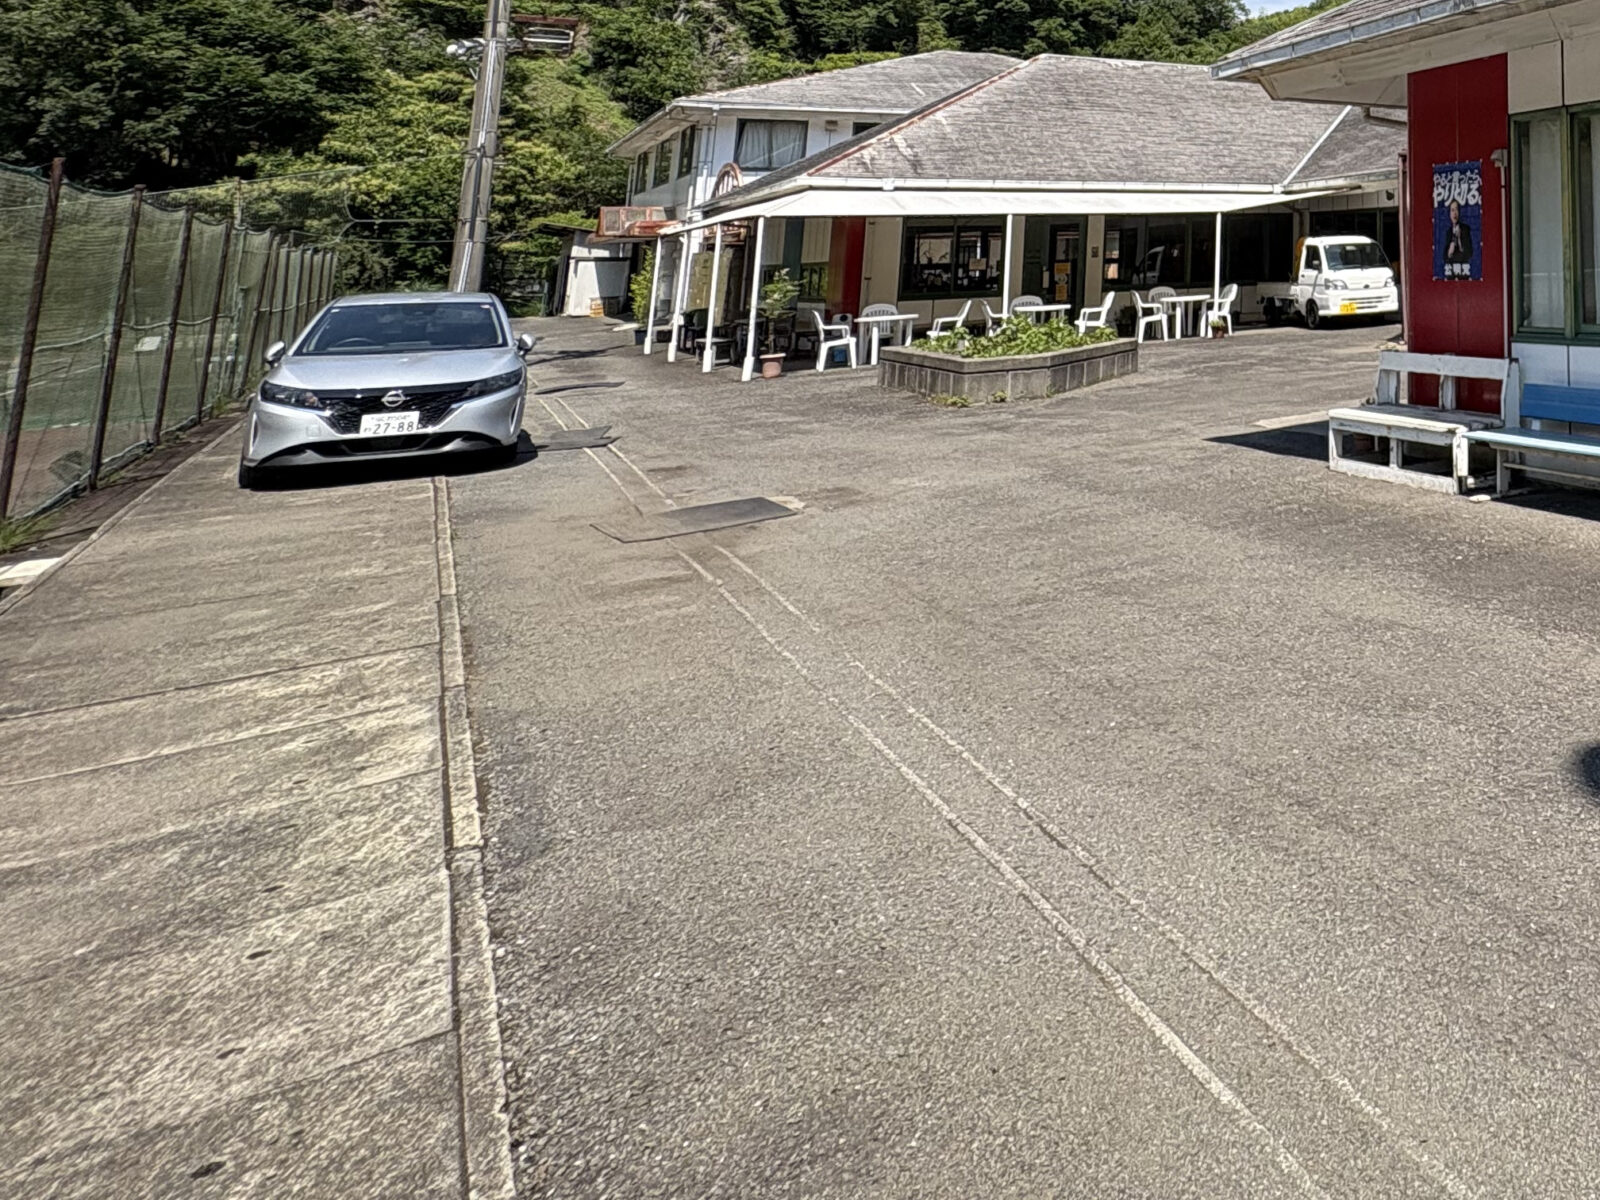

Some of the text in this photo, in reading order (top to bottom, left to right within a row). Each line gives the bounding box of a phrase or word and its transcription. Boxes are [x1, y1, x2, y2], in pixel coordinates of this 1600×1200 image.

[1444, 263, 1471, 276] 公明党
[372, 421, 415, 435] 27-88
